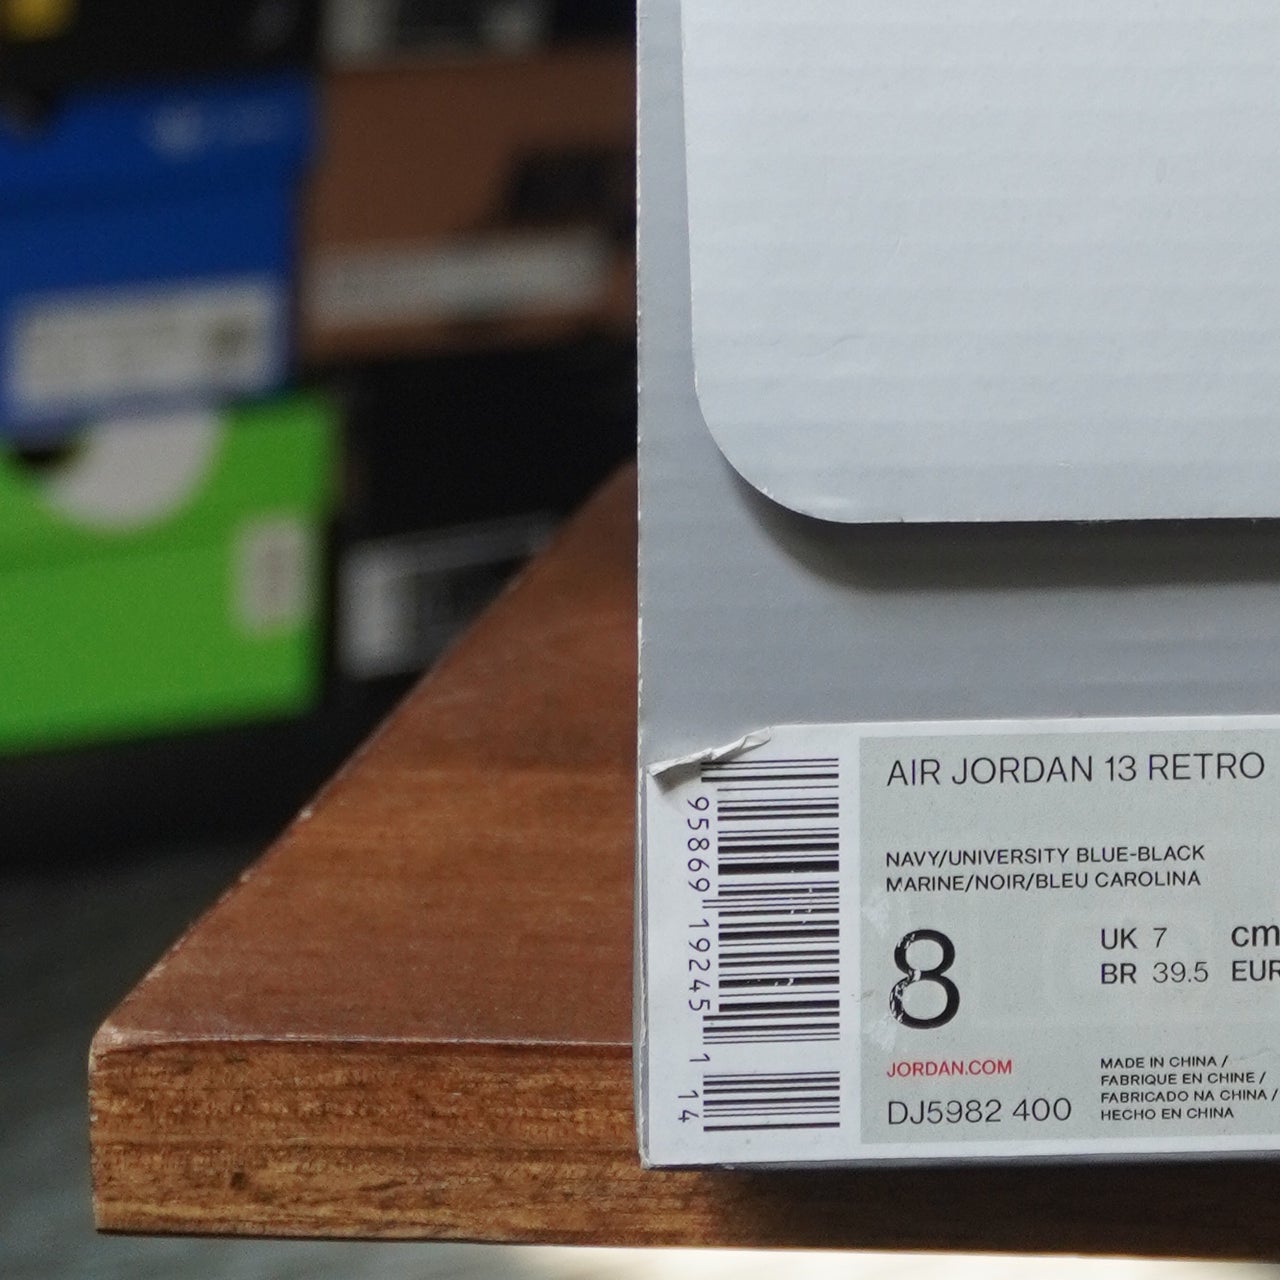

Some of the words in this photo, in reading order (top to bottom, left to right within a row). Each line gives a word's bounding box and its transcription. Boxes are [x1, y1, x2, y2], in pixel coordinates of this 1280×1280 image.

[886, 758, 941, 787] AIR
[951, 755, 1093, 785] JORDAN
[1105, 755, 1137, 782] 13
[1149, 751, 1265, 781] RETRO
[886, 847, 1070, 869] NAVY/UNIVERSITY
[1076, 844, 1205, 863] BLUE-BLACK
[886, 872, 1088, 893] MARINE/NOIR/BLEU
[1094, 870, 1201, 888] CAROLINA
[1101, 927, 1138, 950] UK
[1153, 927, 1168, 948] 7
[1231, 924, 1280, 948] cm
[889, 928, 961, 1030] 8
[1101, 962, 1137, 985] BR
[1152, 961, 1209, 984] 39.5
[886, 1059, 1012, 1078] JORDAN.COM
[1100, 1057, 1145, 1069] MADE
[1149, 1056, 1165, 1068] IN
[1169, 1055, 1217, 1068] CHINA
[1100, 1073, 1177, 1086] FABRIQUE
[1182, 1072, 1203, 1085] EN
[1207, 1071, 1255, 1084] CHINE
[677, 1089, 700, 1123] 14
[1100, 1090, 1189, 1104] FABRICADO
[1198, 1090, 1215, 1101] NA
[1219, 1089, 1268, 1101] CHINA
[888, 1098, 1002, 1125] DJ5982
[1012, 1097, 1072, 1122] 400
[1100, 1108, 1157, 1121] HECHO
[1161, 1108, 1182, 1120] EN
[1186, 1107, 1235, 1119] CHINA
